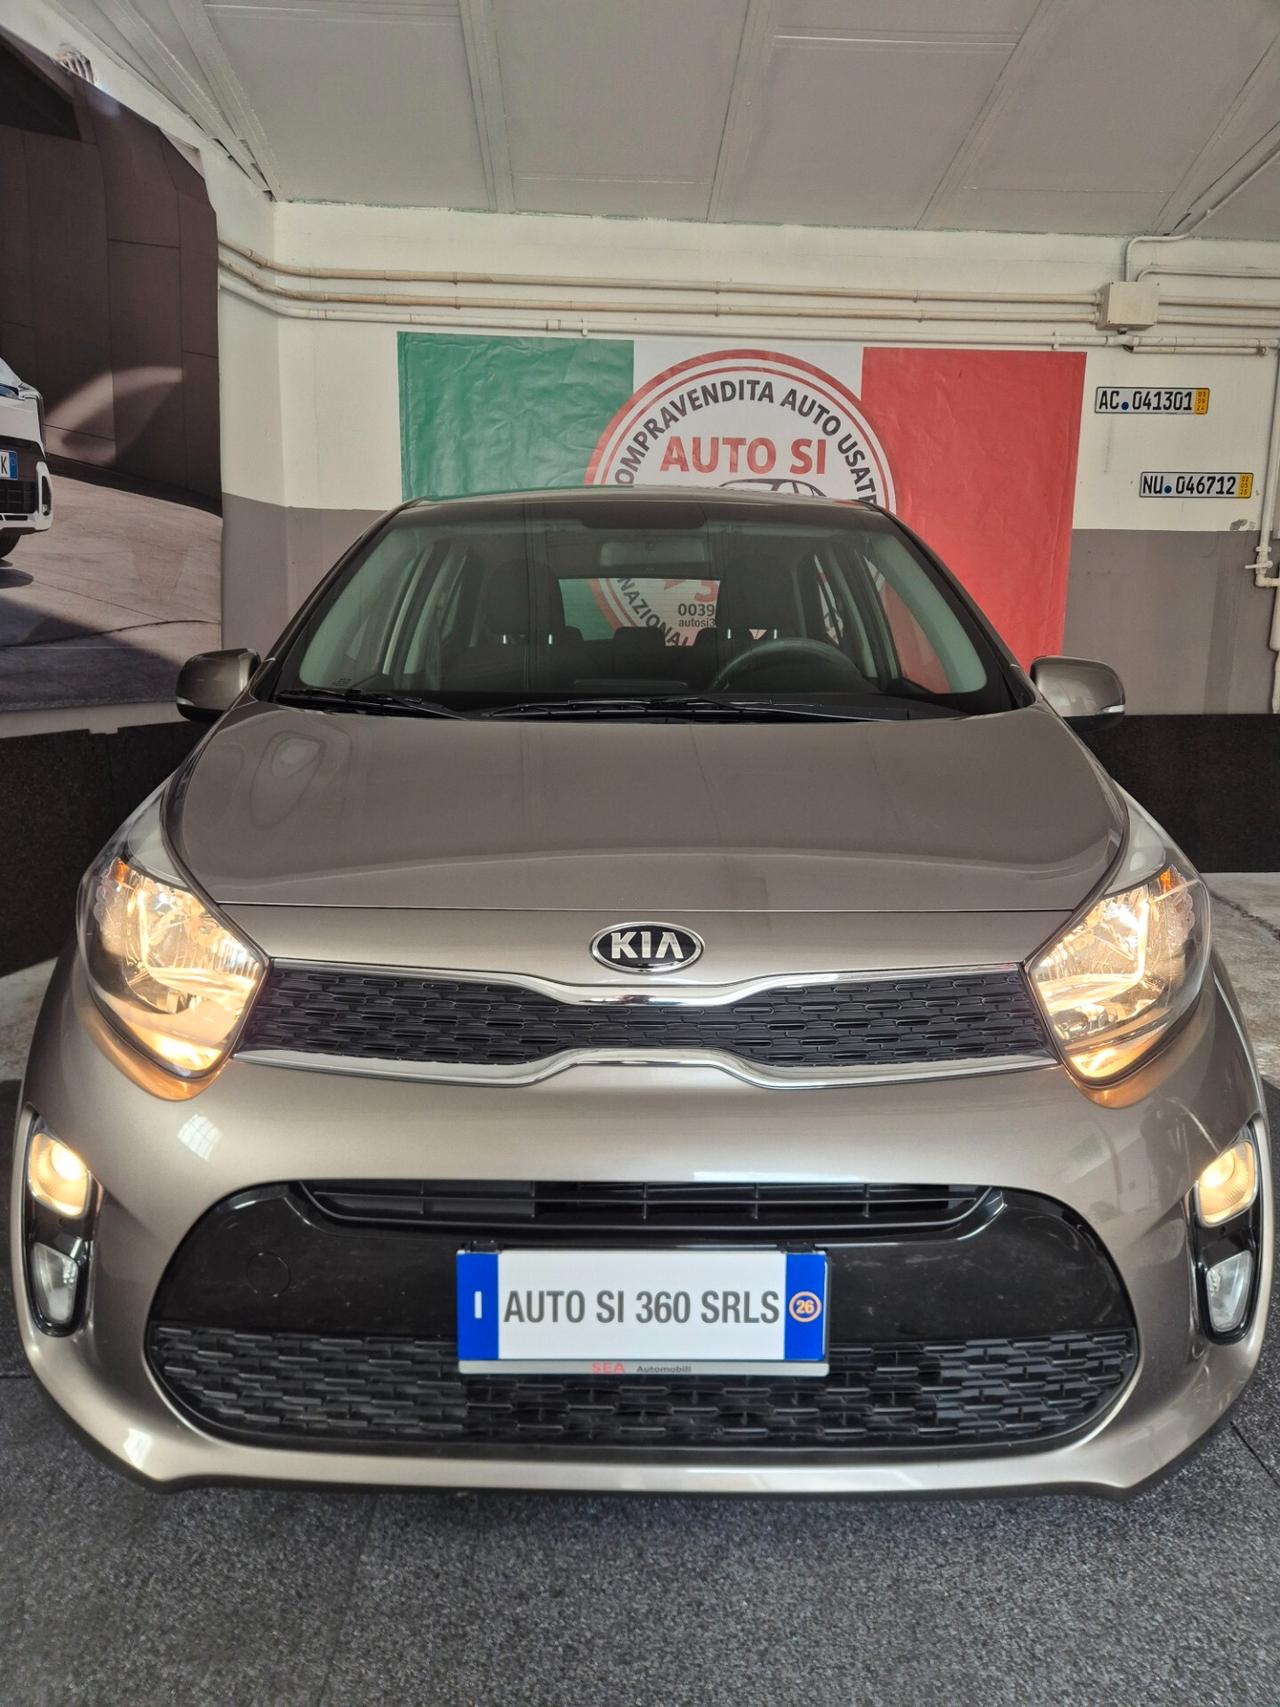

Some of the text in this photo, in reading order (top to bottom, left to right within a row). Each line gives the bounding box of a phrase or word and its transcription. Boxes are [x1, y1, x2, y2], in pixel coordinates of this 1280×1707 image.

[1098, 390, 1193, 411] AC 041301
[614, 379, 775, 484] OMPRAVENDITA
[780, 388, 841, 437] AUTO
[660, 435, 827, 475] AUTO SI
[1142, 475, 1236, 495] NU 046712
[678, 603, 715, 617] 0039
[610, 931, 684, 959] KIA
[474, 1290, 814, 1324] I AUTO SI 360 SRLS 26
[591, 1362, 625, 1374] SEA
